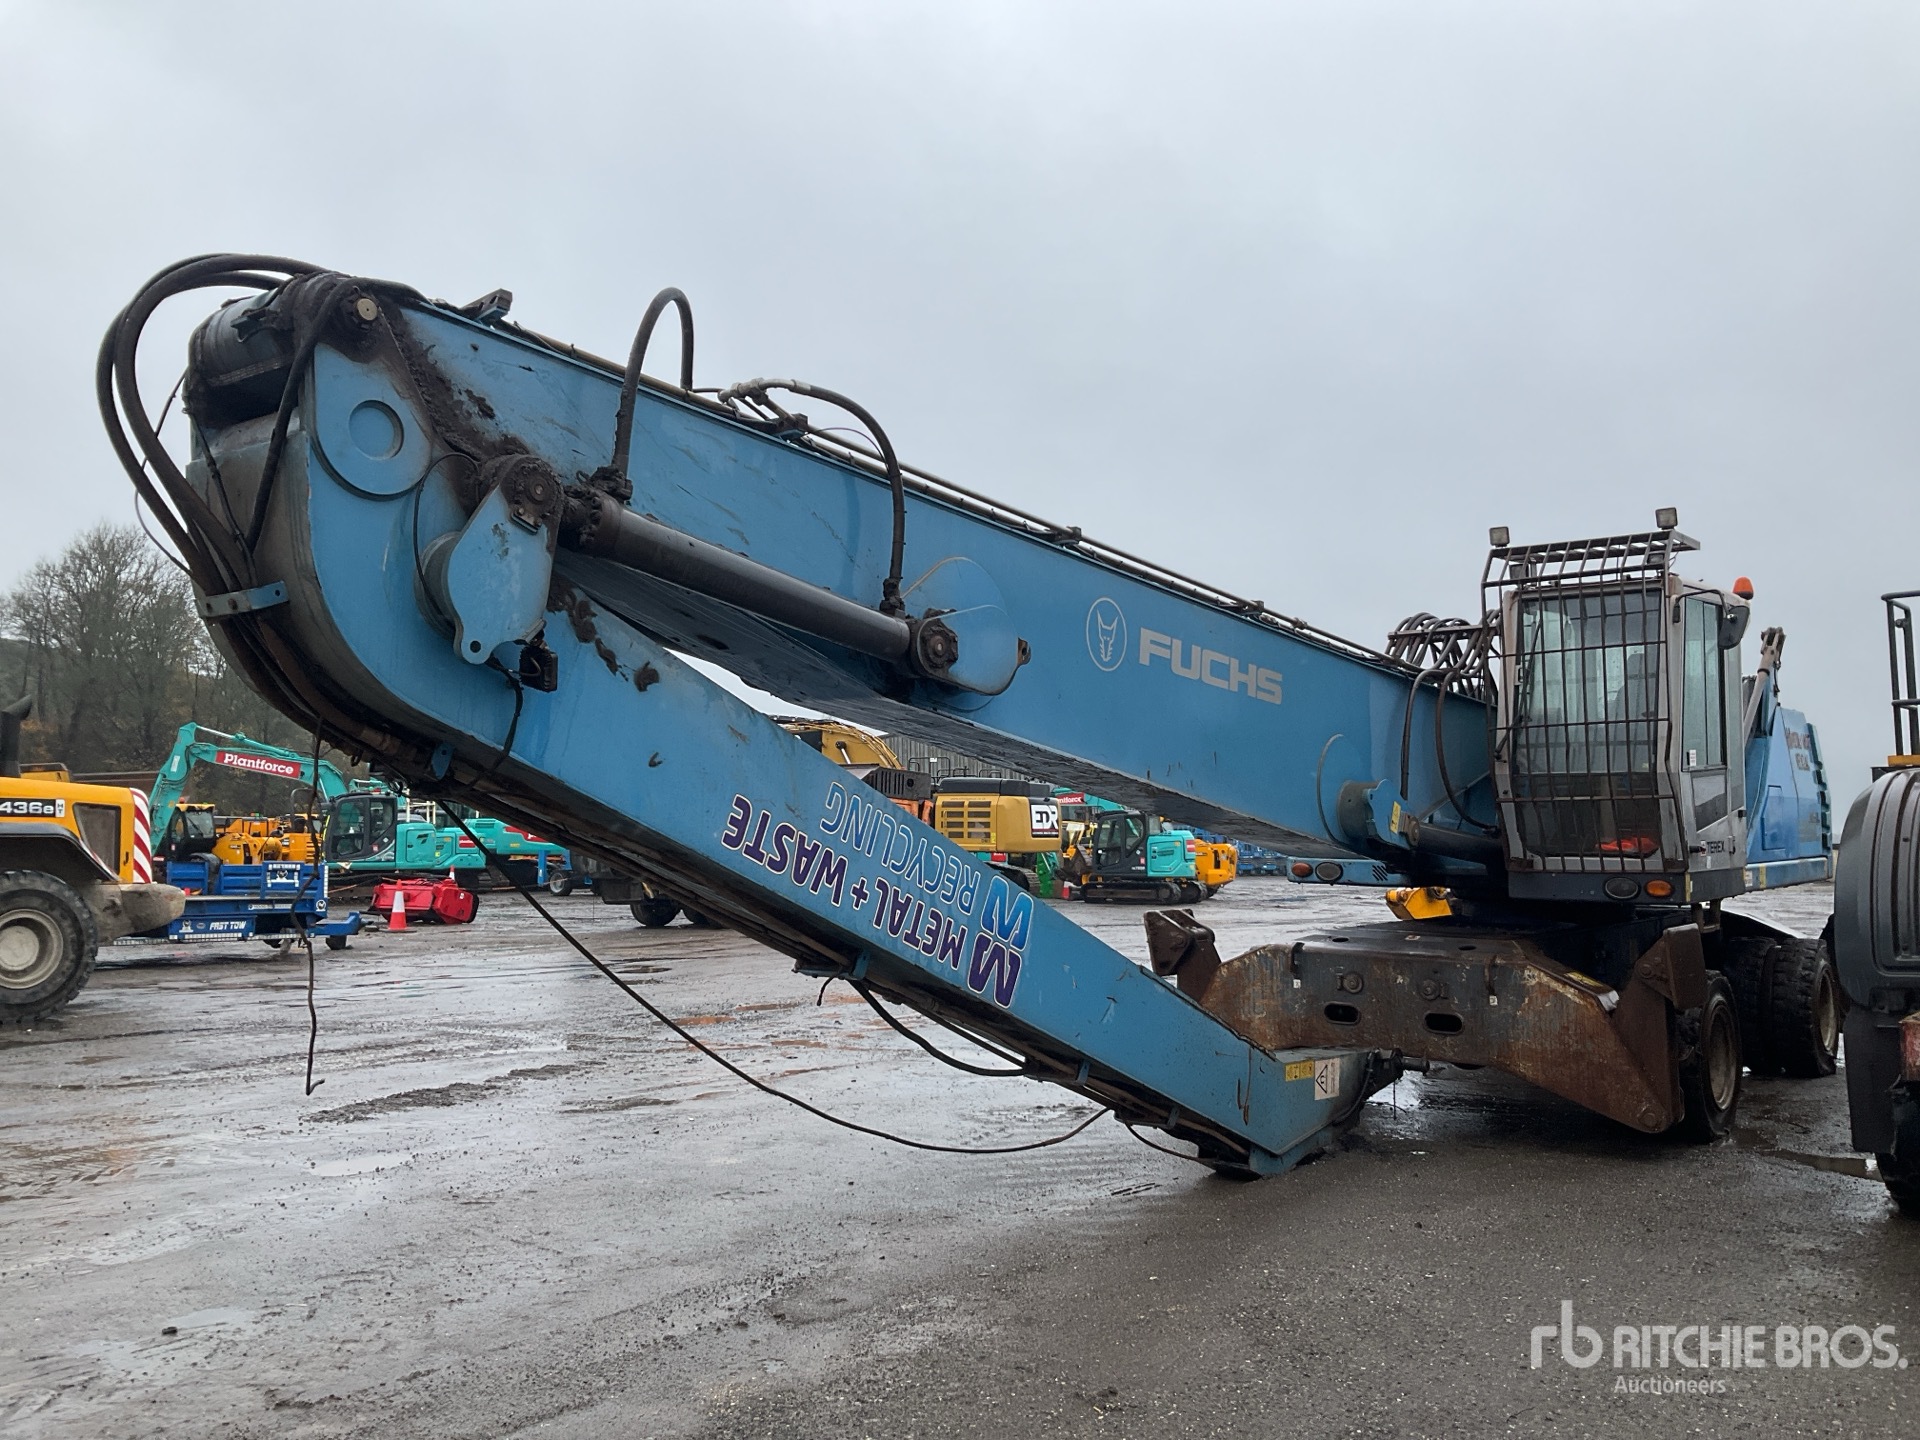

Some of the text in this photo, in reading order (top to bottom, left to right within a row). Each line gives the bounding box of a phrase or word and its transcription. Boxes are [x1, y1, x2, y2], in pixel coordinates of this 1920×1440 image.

[1138, 627, 1283, 705] FUCHS
[223, 753, 294, 774] Plantforce
[0, 801, 54, 814] 436e
[1031, 804, 1059, 829] EDR
[819, 781, 981, 916] RECYCLING
[1706, 841, 1725, 853] TEREX
[721, 793, 968, 970] METAL + WASTE
[209, 920, 247, 930] FAST TOW
